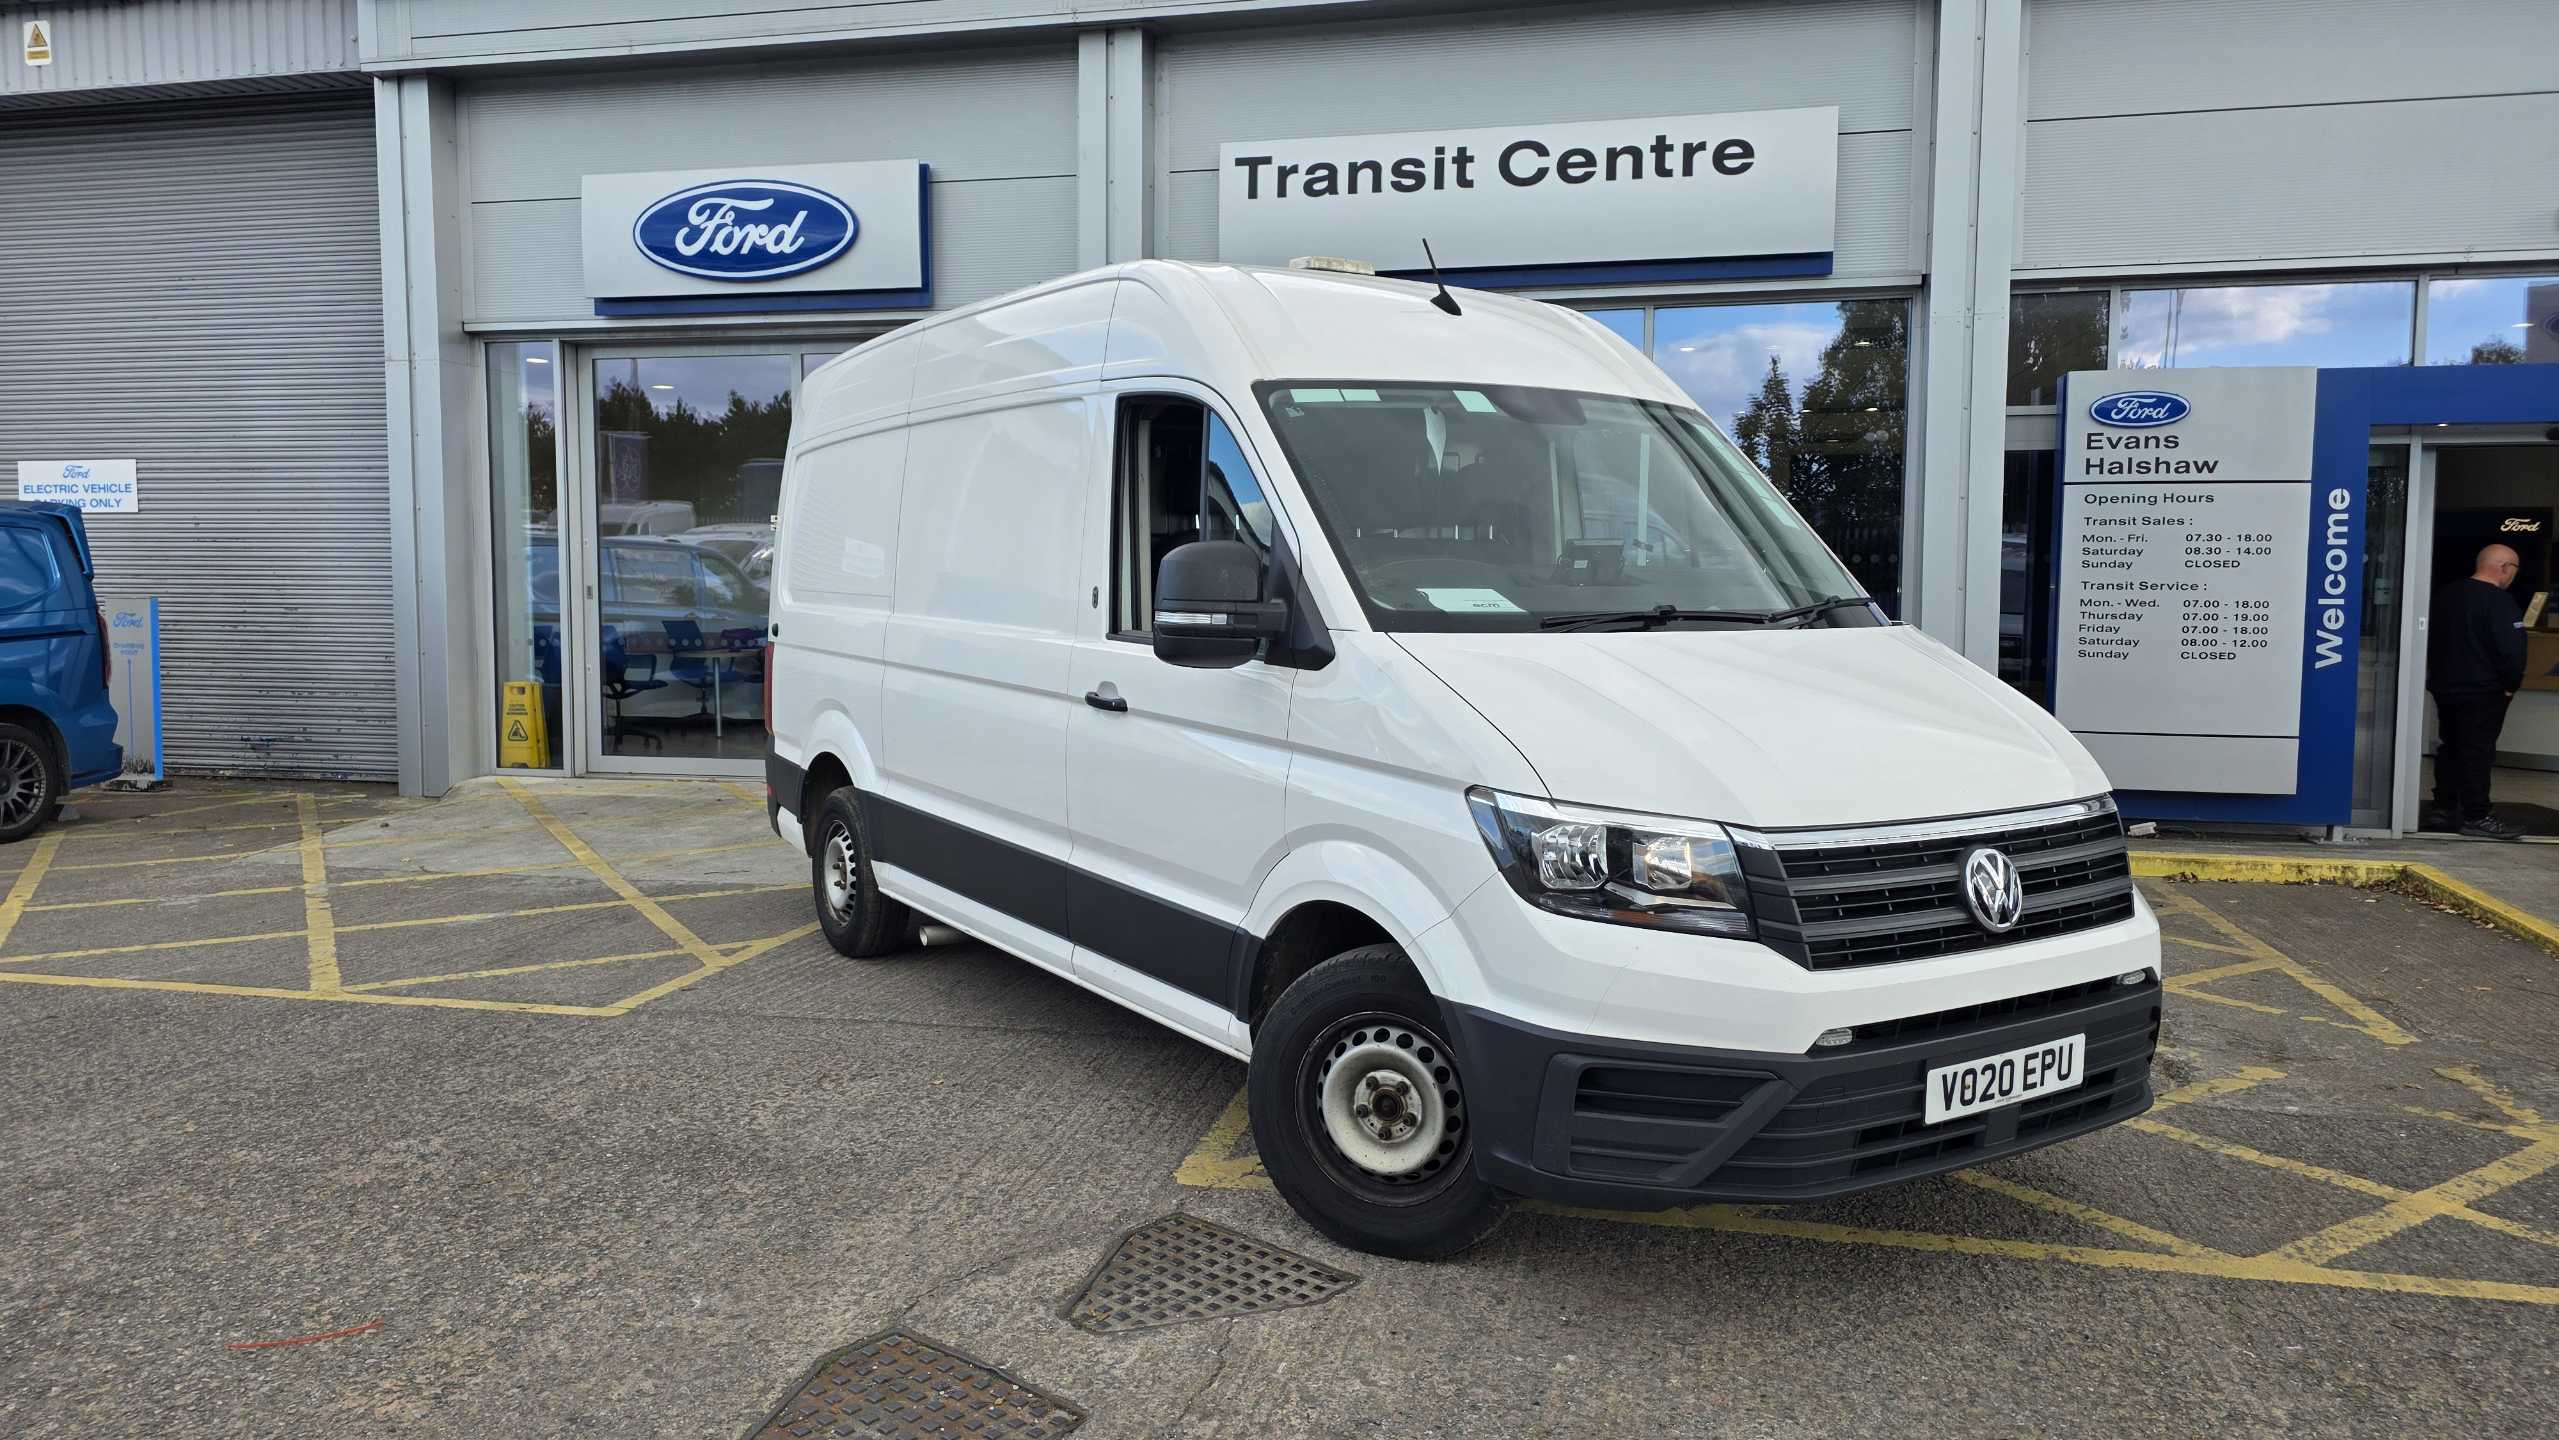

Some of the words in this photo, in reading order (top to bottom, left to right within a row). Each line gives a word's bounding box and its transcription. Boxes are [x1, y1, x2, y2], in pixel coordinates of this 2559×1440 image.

[1234, 145, 1475, 200] Transit
[1498, 134, 1755, 187] Centre
[674, 197, 808, 257] Ford
[2110, 397, 2172, 419] Ford
[2086, 432, 2180, 450] Evans
[62, 464, 90, 479] Ford
[2085, 457, 2219, 475] Halshaw
[23, 484, 79, 494] ELECTRIC
[82, 483, 132, 493] VEHICLE
[89, 498, 122, 508] ONLY
[2084, 493, 2158, 506] Opening
[2163, 493, 2215, 503] Hours
[2084, 517, 2137, 526] Transit
[2142, 517, 2185, 526] Sales
[2500, 518, 2541, 532] Ford
[2082, 534, 2117, 543] Mon.
[2127, 534, 2148, 543] Fri.
[2185, 534, 2223, 542] 07.30
[2237, 534, 2272, 542] 18.00
[2081, 547, 2144, 557] Saturday
[2184, 547, 2222, 556] 08.30
[2237, 547, 2272, 556] 14.00
[2081, 560, 2133, 570] Sunday
[2184, 560, 2241, 569] CLOSED
[2314, 488, 2351, 669] Welcome
[2081, 581, 2134, 590] Transit
[2138, 581, 2199, 590] Service
[2079, 599, 2114, 607] Mon.
[2125, 599, 2160, 608] Wed.
[2183, 600, 2220, 608] 07.00
[2235, 600, 2270, 609] 18.00
[2080, 612, 2144, 622] Thursday
[2182, 613, 2219, 621] 07.00
[2234, 613, 2269, 622] 19.00
[2079, 624, 2120, 634] Friday
[2181, 626, 2219, 635] 07.00
[2233, 627, 2269, 635] 18.00
[2078, 637, 2140, 647] Saturday
[2181, 639, 2218, 648] 08.00
[2232, 640, 2268, 648] 12.00
[2078, 650, 2129, 660] Sunday
[2180, 652, 2236, 660] CLOSED
[2023, 1043, 2073, 1092] EPU
